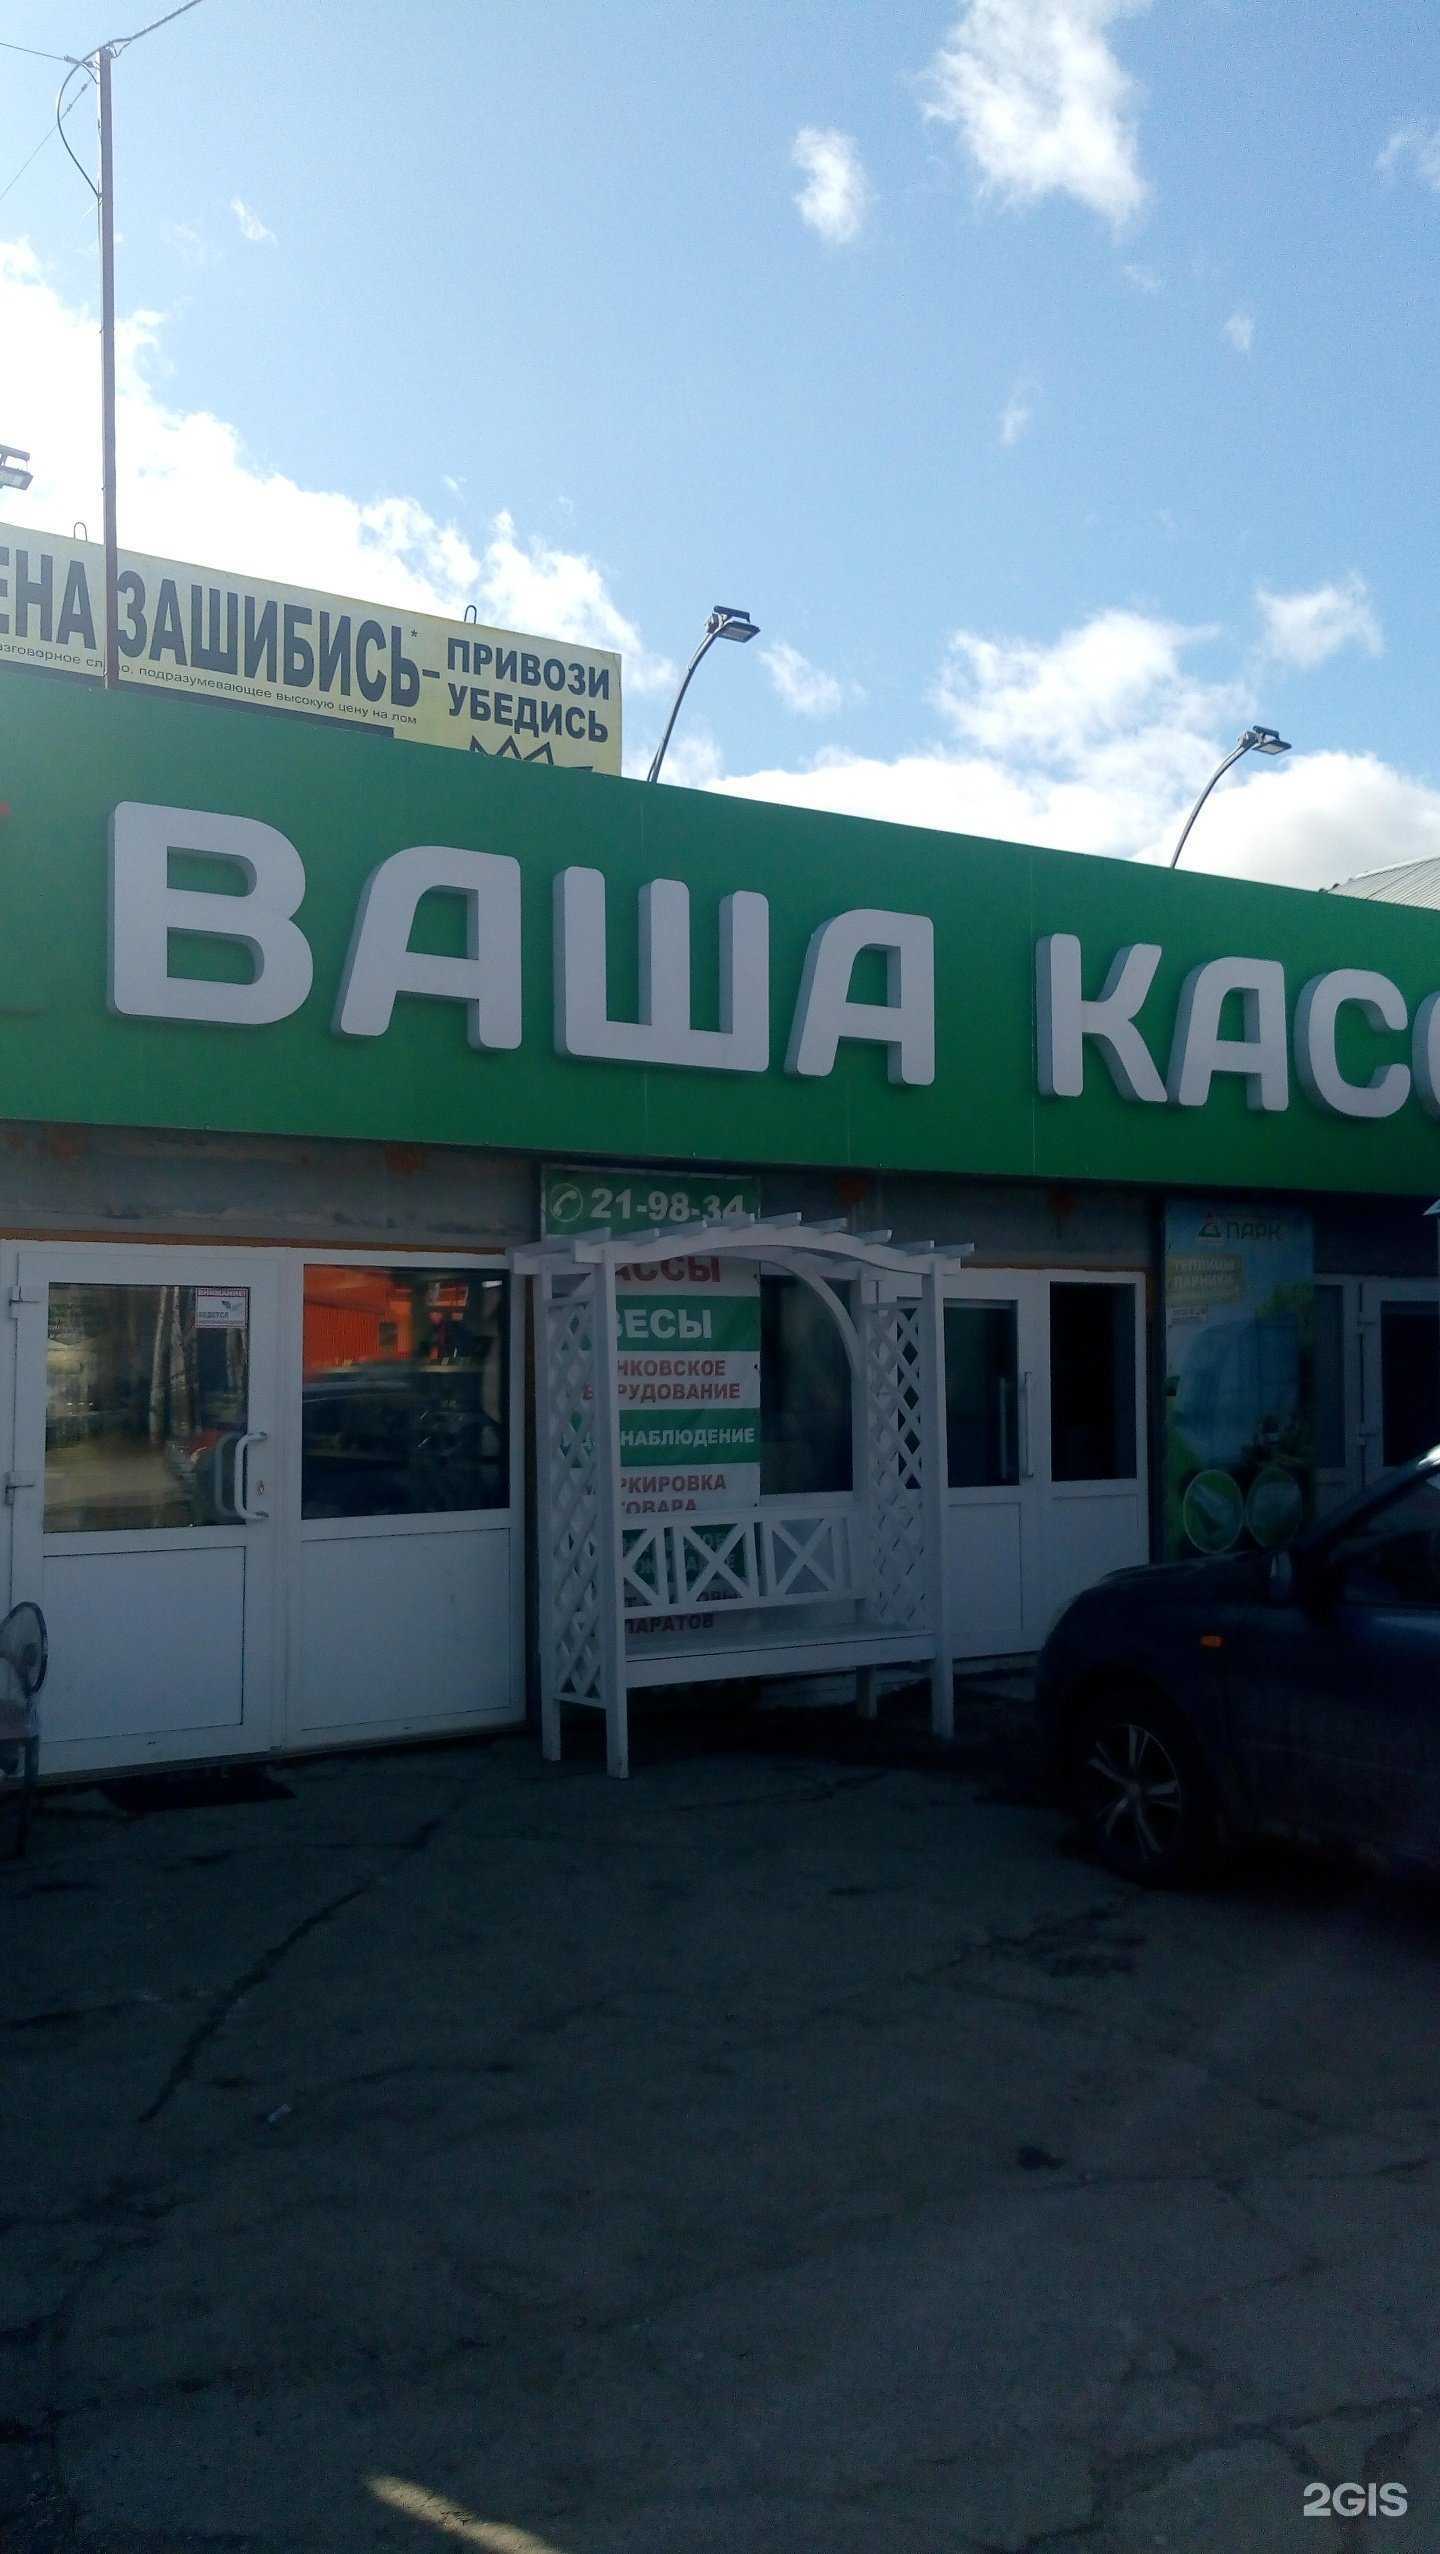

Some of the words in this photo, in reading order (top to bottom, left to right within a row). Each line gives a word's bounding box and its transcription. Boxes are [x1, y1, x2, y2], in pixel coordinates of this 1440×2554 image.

[86, 658, 134, 674] сло,
[139, 667, 272, 698] подразумевающее
[276, 692, 335, 710] высокую
[338, 703, 369, 718] цену
[372, 710, 388, 719] на
[391, 713, 417, 725] лом
[447, 637, 610, 700] ПРИВОЗИ
[448, 683, 609, 743] УБЕДИСЬ
[107, 800, 935, 1087] ВАША
[1036, 933, 1440, 1123] КАС
[591, 1188, 746, 1222] 21-98-34
[620, 1427, 755, 1448] НАБЛЮДЕНИЕ
[622, 1499, 697, 1514] ОВАРА
